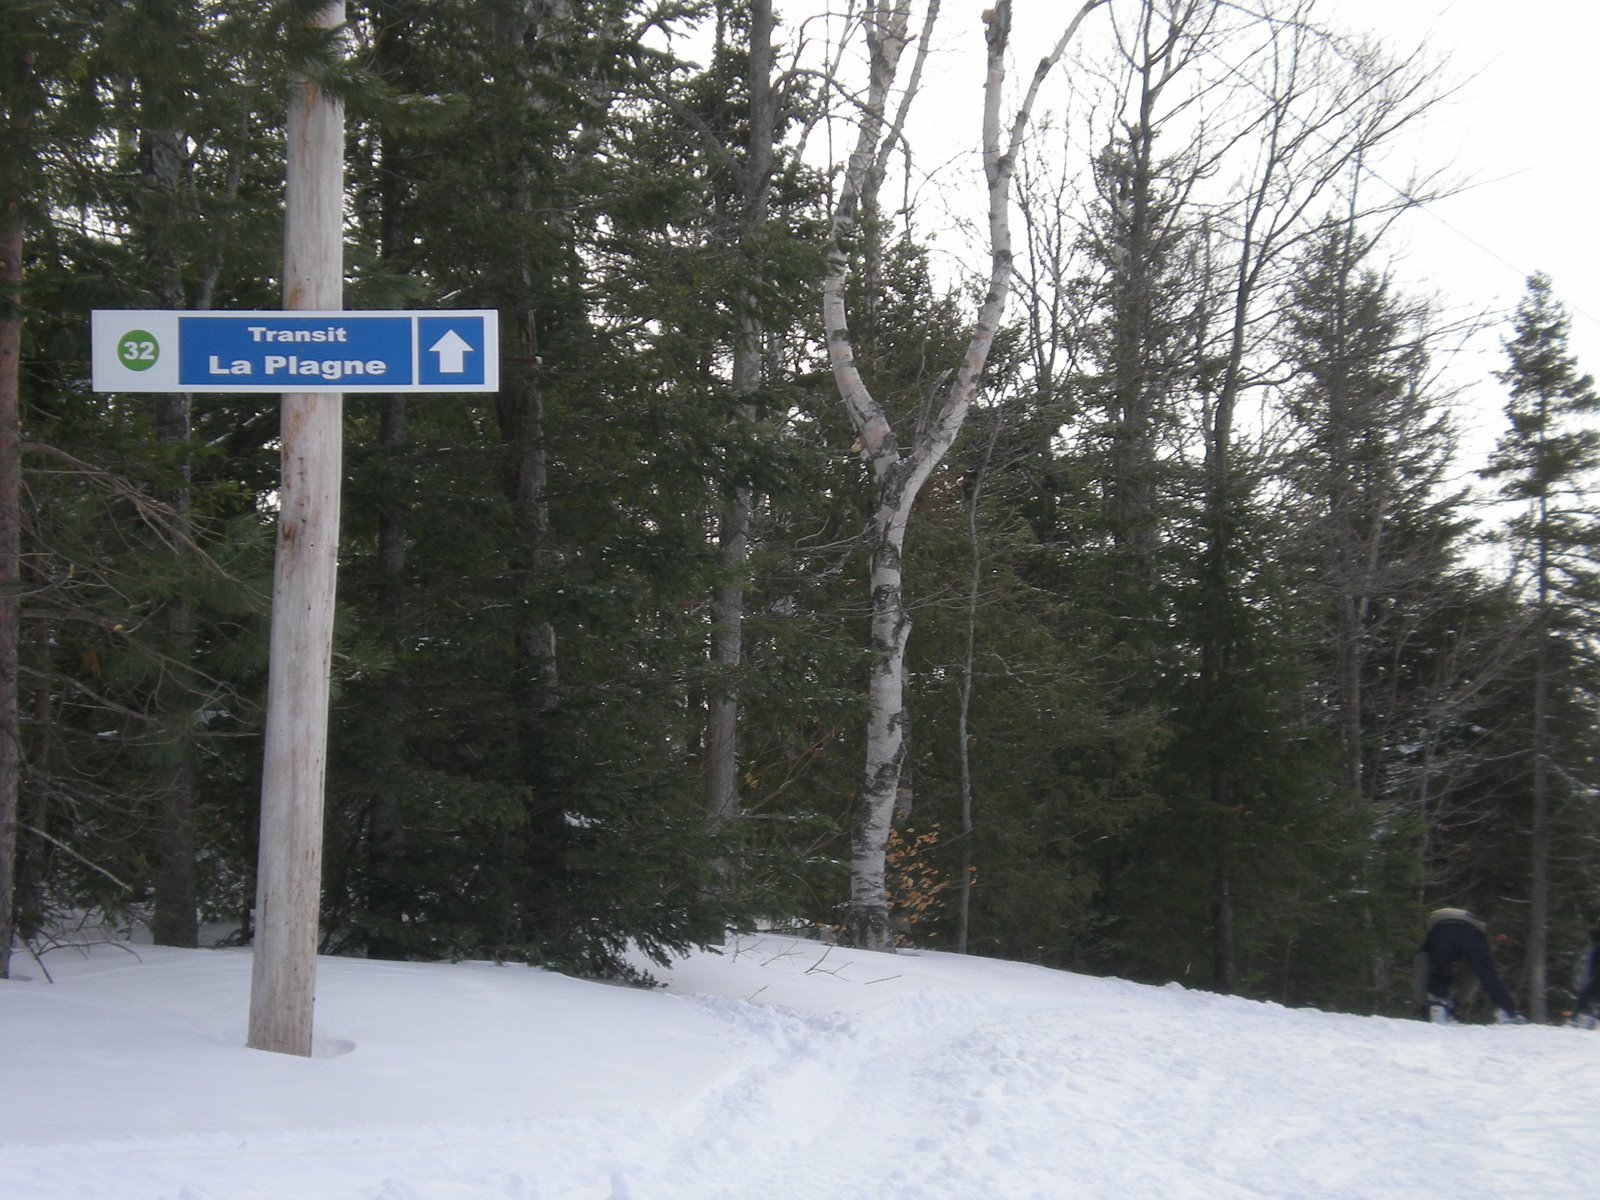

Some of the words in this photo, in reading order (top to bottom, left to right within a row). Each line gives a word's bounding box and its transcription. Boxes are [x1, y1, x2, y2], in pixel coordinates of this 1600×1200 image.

[247, 327, 347, 342] Transit
[123, 341, 155, 361] 32
[208, 355, 252, 375] La
[265, 355, 387, 380] Plagne
